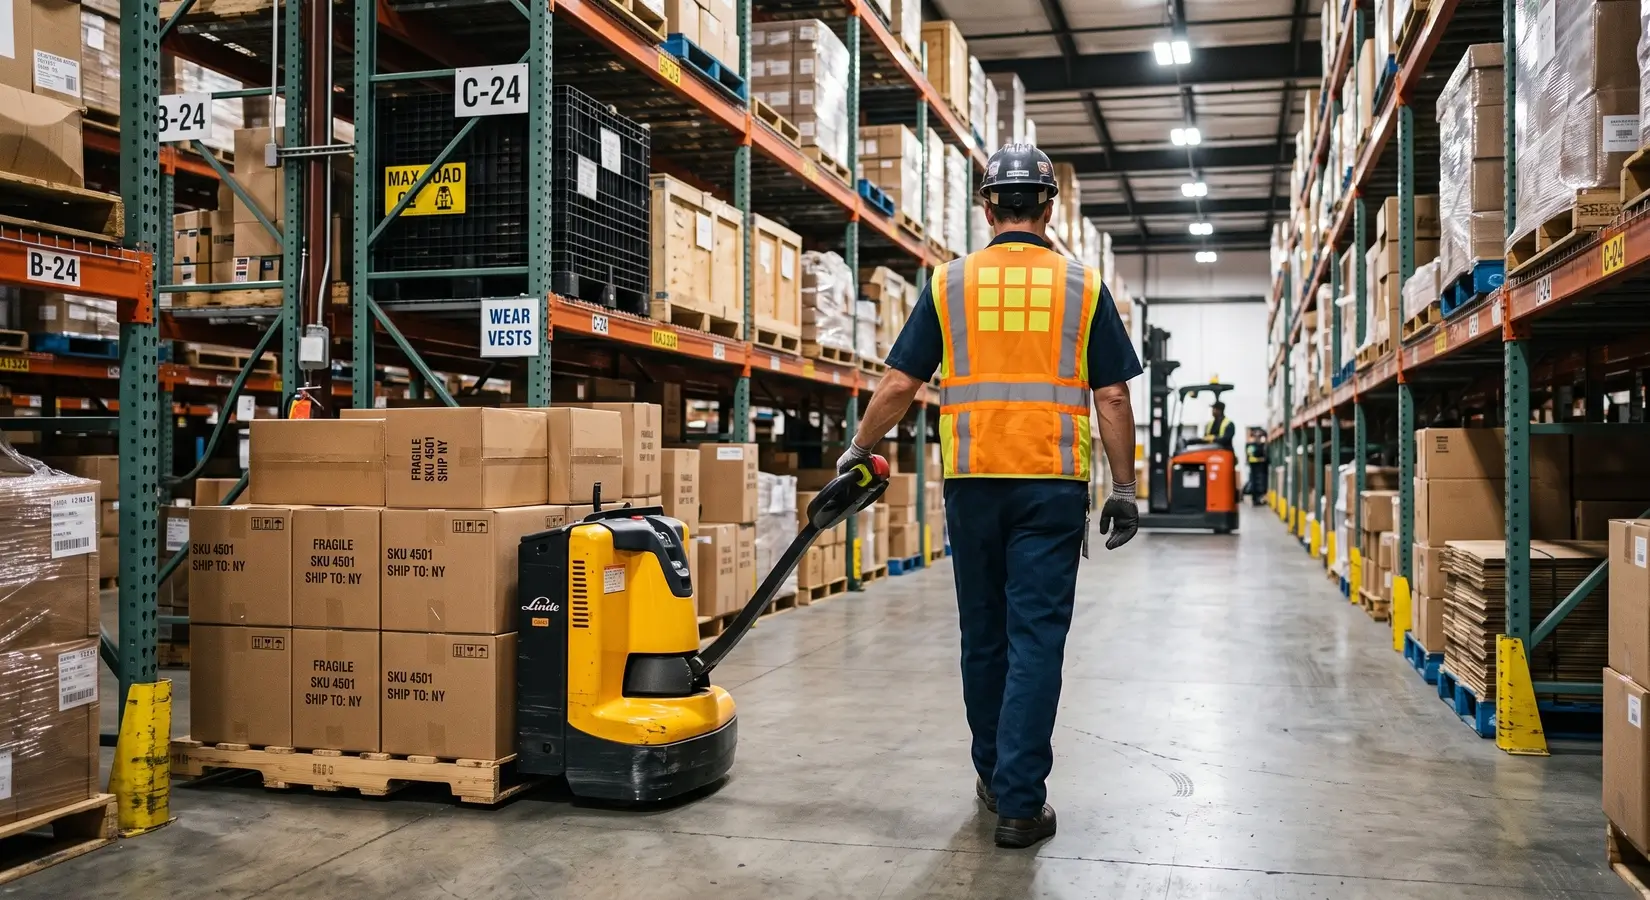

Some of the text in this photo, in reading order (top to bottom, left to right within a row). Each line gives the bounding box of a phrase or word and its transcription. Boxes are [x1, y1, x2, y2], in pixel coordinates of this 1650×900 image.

[463, 75, 520, 107] C-24
[159, 103, 205, 132] B-24
[389, 168, 461, 186] MAX OAD
[1603, 237, 1623, 271] C-24
[31, 253, 77, 282] B-24
[490, 308, 530, 324] WEAR
[593, 316, 607, 332] C-24
[488, 330, 532, 346] VESTS
[411, 439, 421, 481] FRAGILE
[425, 437, 434, 481] SKU 4501
[437, 440, 447, 481] SHIP NY
[193, 544, 234, 556] SKU 4501
[314, 539, 353, 551] FRAGILE
[388, 548, 433, 560] SKU 4501
[193, 560, 245, 572] SHIP TO: NY
[311, 556, 355, 568] SKU 4501
[305, 572, 361, 584] SHIP TO: NY
[387, 565, 445, 577] SHIP TO: NY
[522, 597, 560, 611] Linde
[314, 660, 353, 672] FRAGILE
[311, 677, 355, 689] SKU 4501
[388, 671, 433, 684] SKU 4501
[305, 693, 361, 707] SHIP TO: NY
[387, 688, 445, 702] SHIP TO: NY
